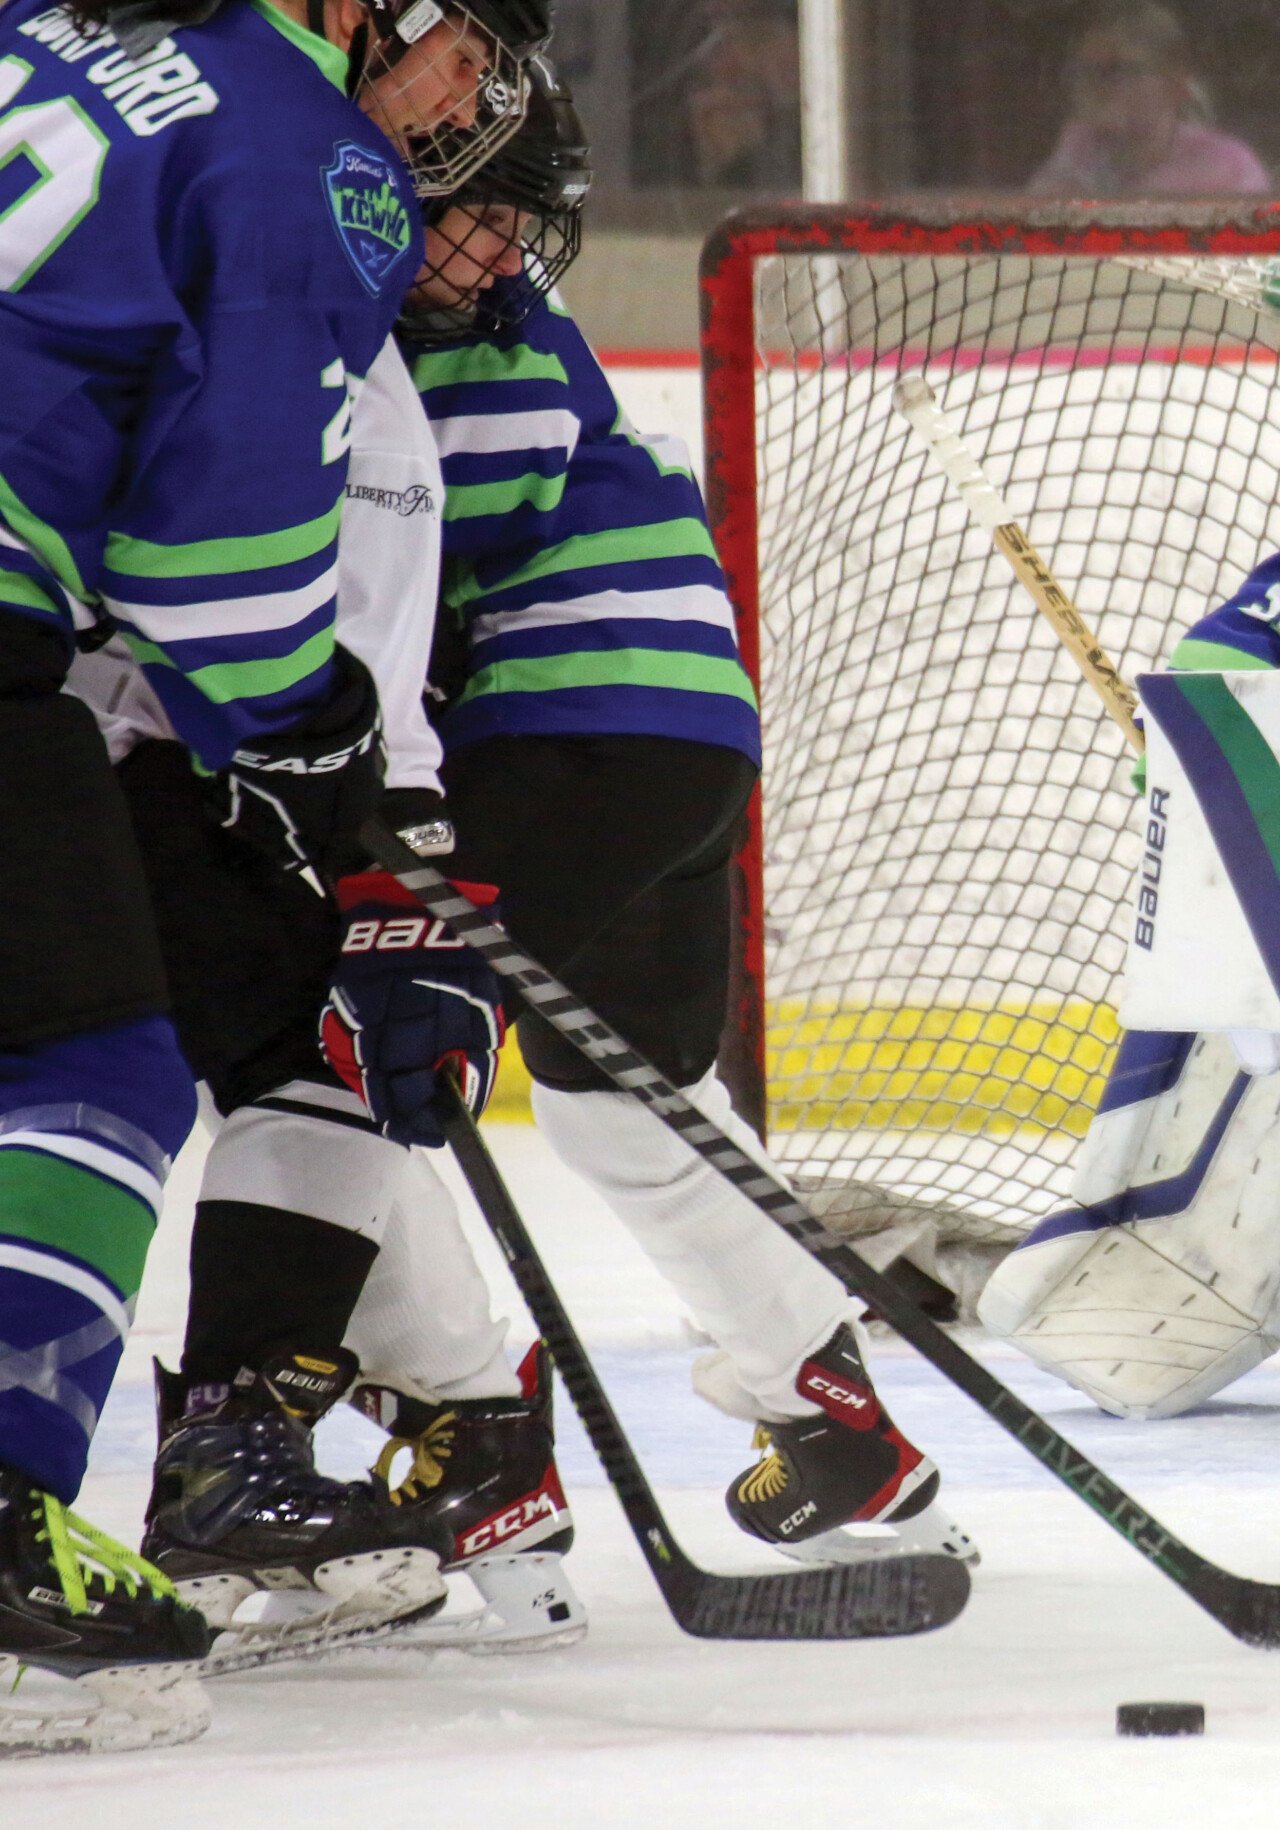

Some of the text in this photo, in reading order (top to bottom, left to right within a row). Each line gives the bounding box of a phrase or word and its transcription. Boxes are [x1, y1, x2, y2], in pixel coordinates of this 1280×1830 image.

[346, 484, 405, 506] LIBERTY
[1135, 786, 1170, 952] BAUER
[807, 1376, 868, 1410] CCM
[463, 1492, 552, 1555] CCM
[779, 1500, 818, 1535] CCM
